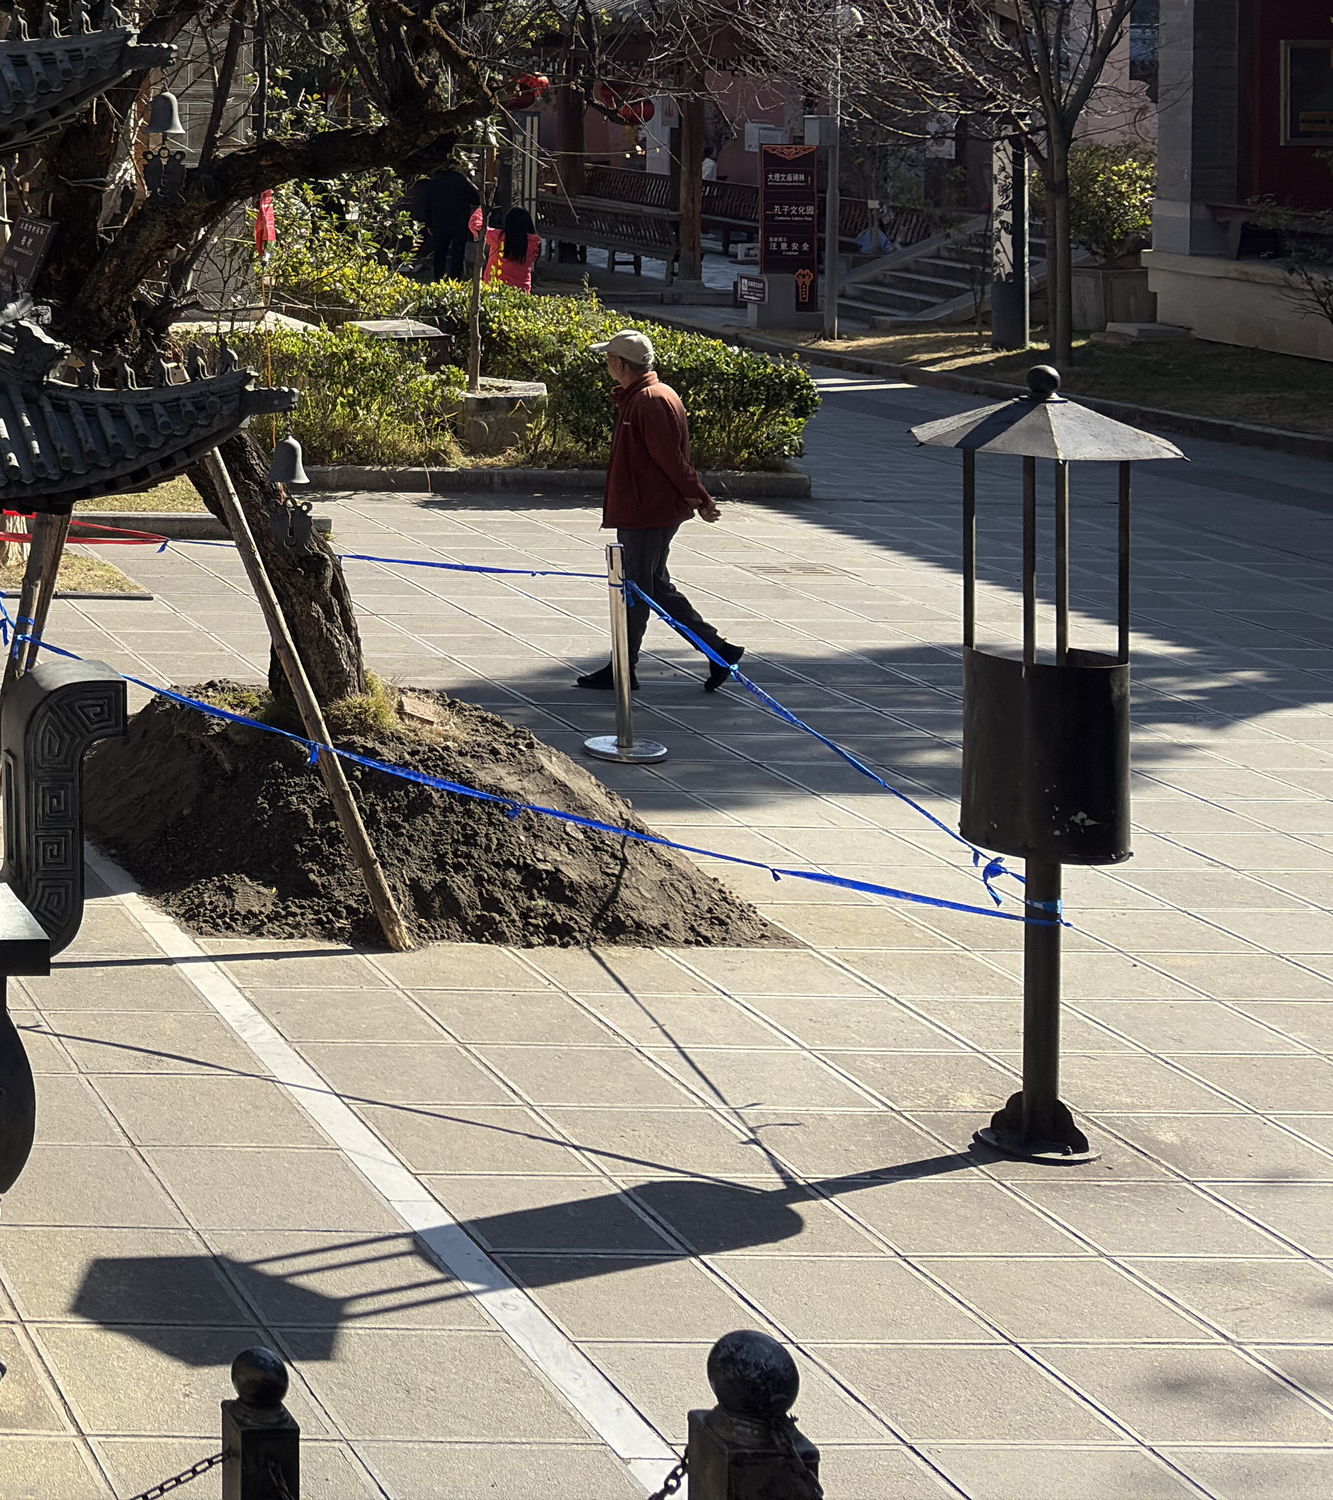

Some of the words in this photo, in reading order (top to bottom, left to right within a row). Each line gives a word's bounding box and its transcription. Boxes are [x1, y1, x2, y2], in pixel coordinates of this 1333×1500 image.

[773, 205, 814, 215] 孔子文化园
[769, 242, 810, 251] 注意安全
